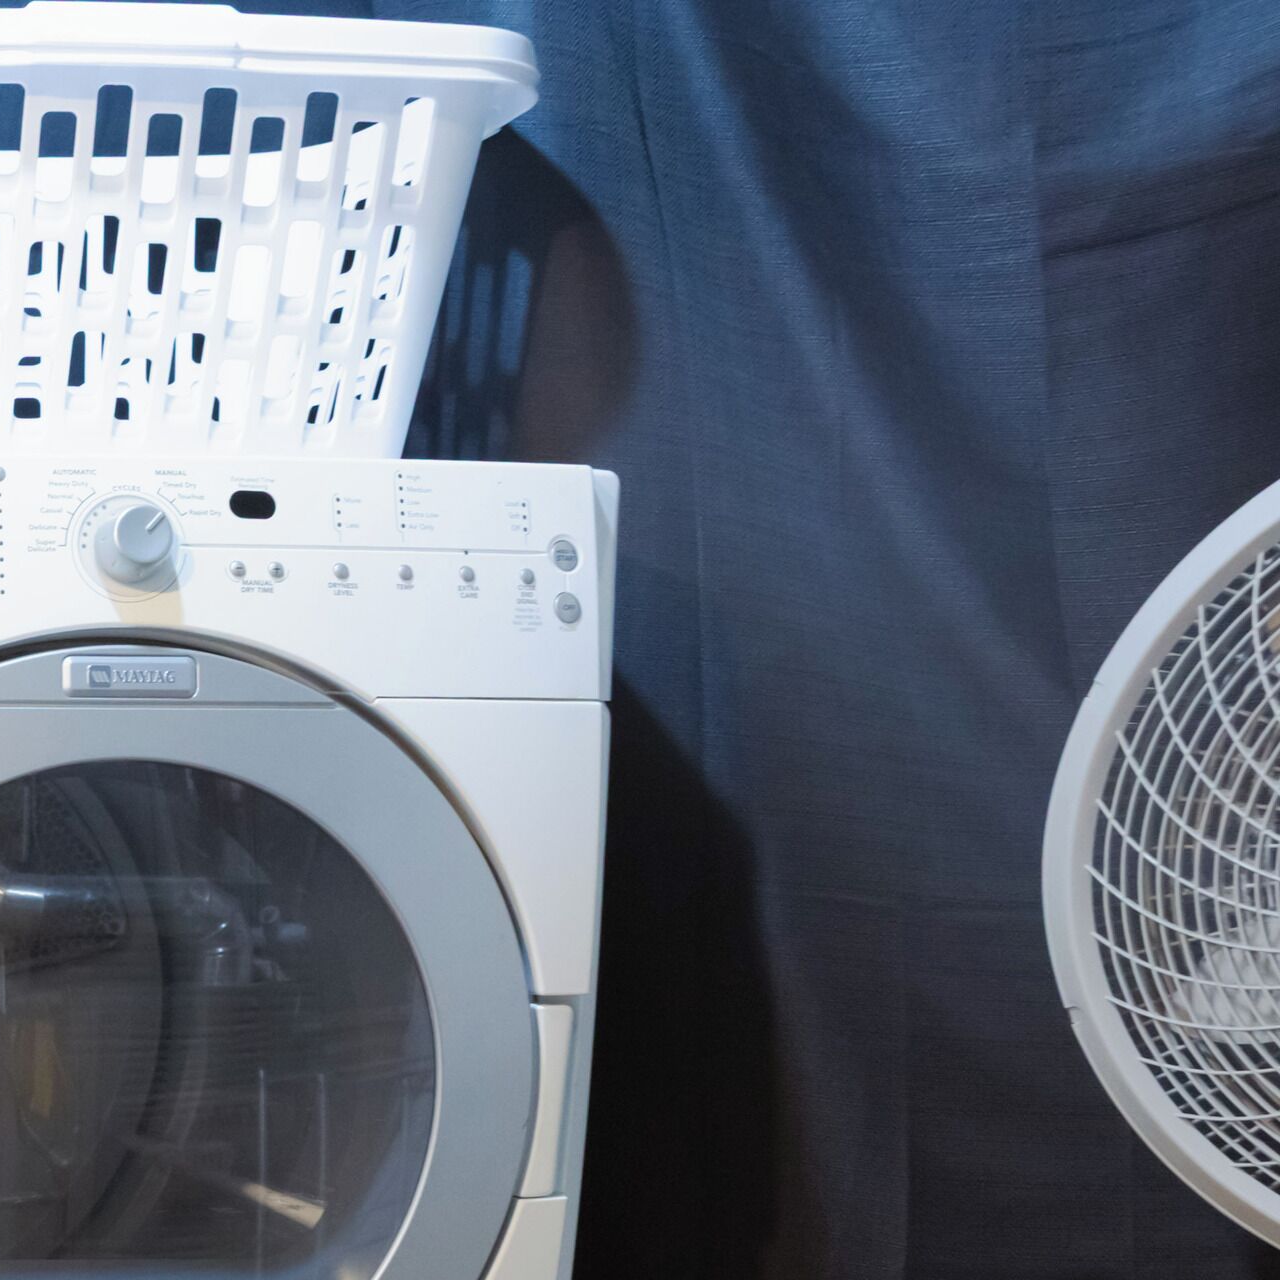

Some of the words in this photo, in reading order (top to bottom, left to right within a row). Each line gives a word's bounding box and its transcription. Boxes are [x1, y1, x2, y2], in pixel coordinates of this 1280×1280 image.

[111, 485, 142, 493] CYCLES
[185, 482, 197, 490] Dry
[112, 669, 176, 684] MAYTAG
